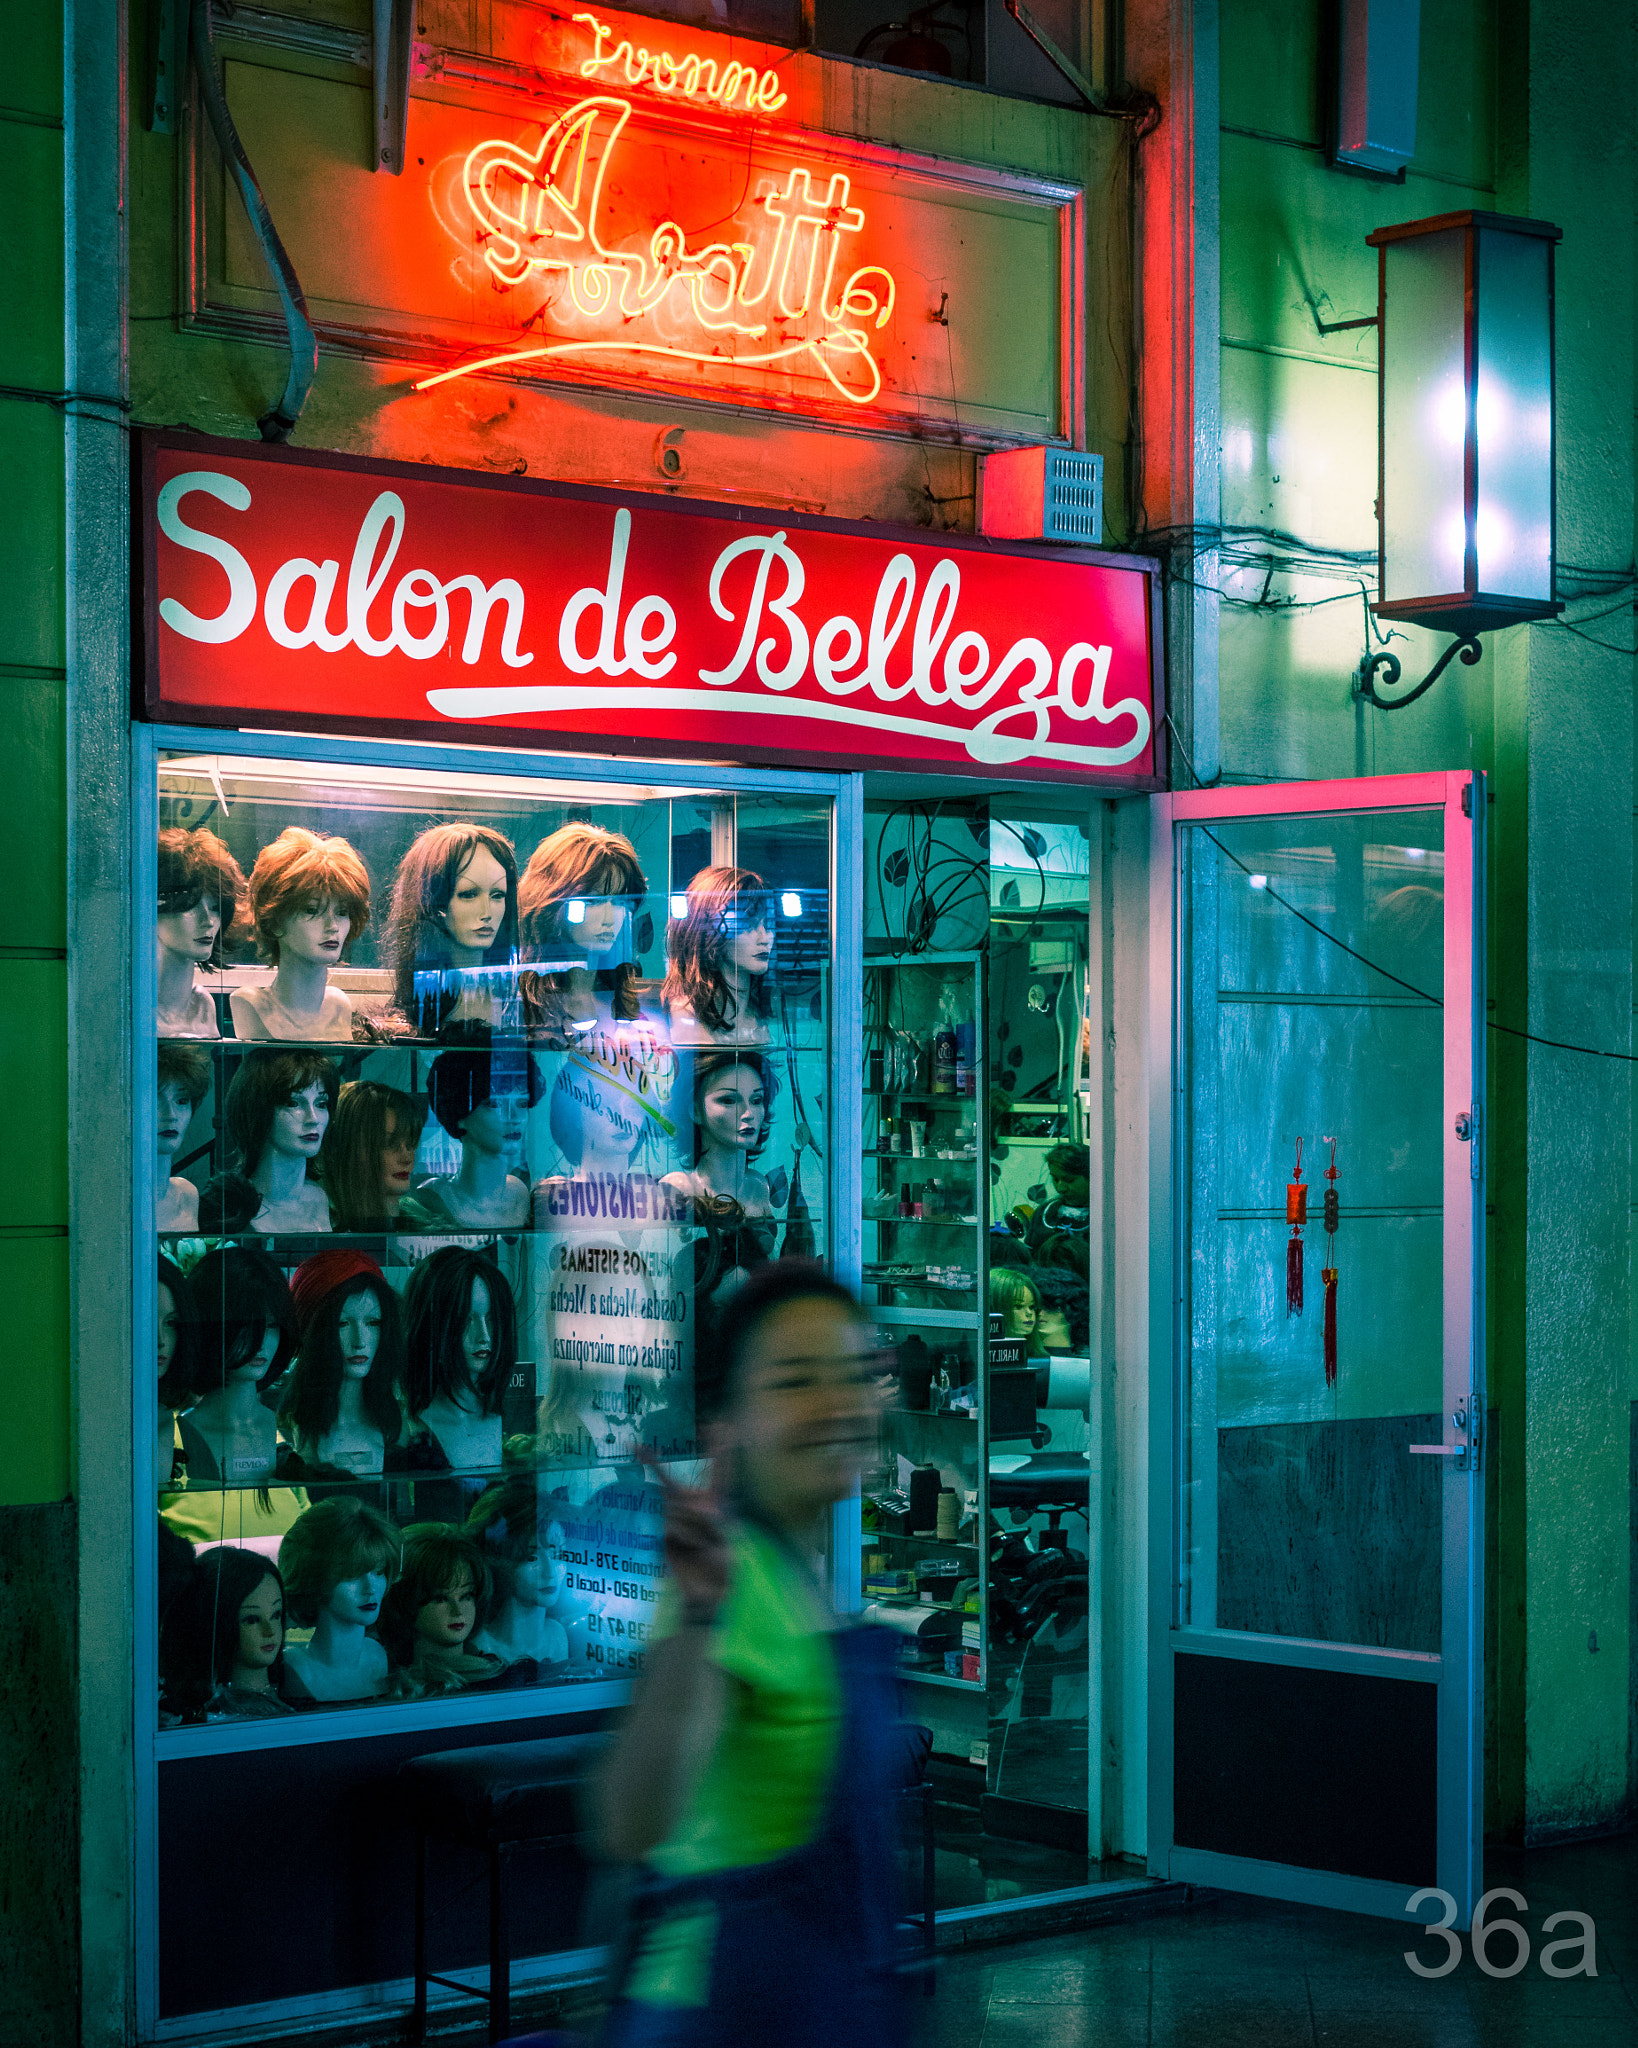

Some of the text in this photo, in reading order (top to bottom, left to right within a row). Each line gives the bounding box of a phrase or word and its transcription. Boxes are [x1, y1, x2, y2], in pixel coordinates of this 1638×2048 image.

[157, 471, 1150, 765] Salon de Belleza
